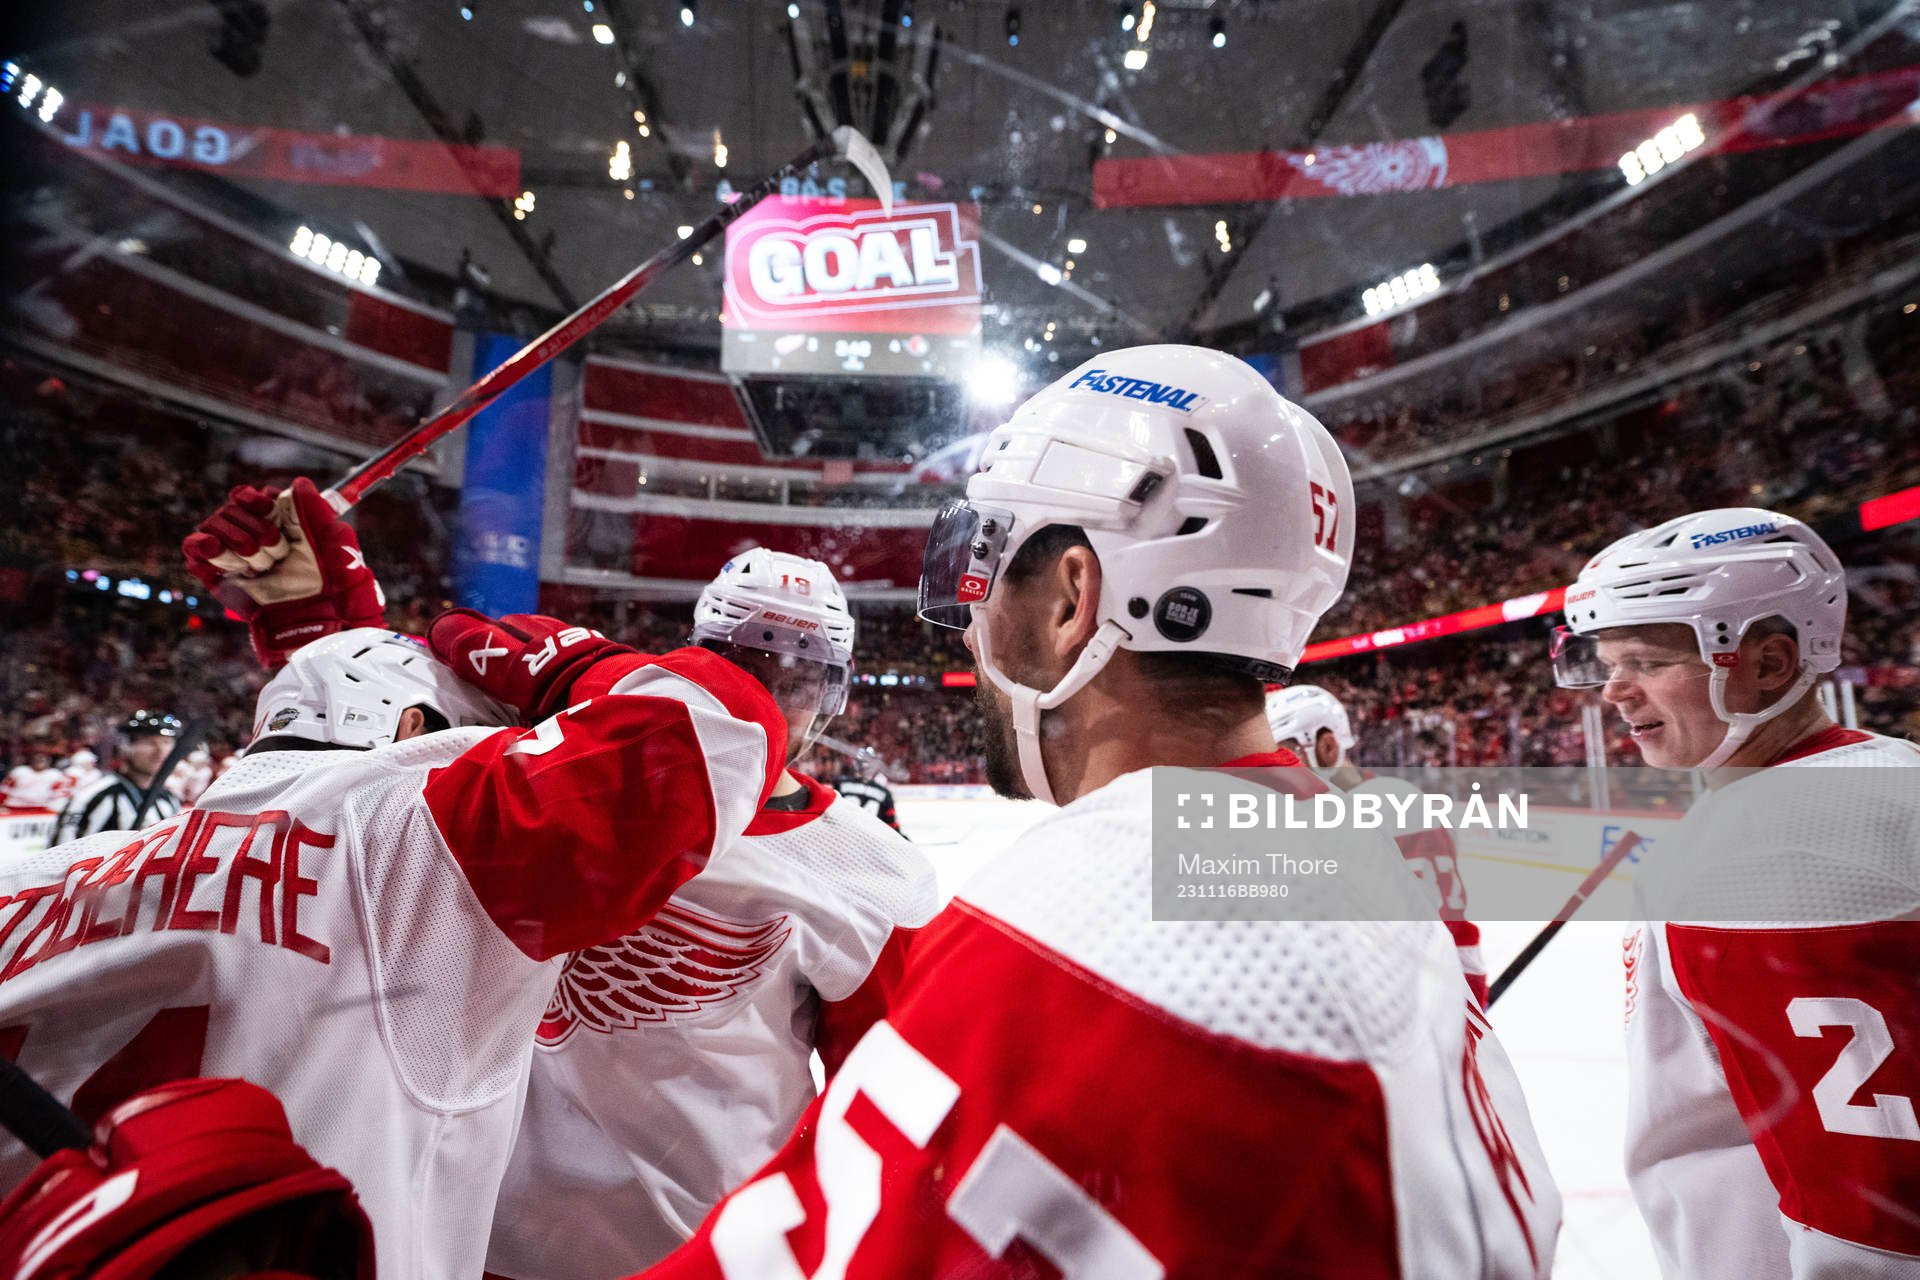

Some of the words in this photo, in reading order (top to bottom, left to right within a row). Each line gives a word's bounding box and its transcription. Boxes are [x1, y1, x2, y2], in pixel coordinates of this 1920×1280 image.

[749, 228, 957, 301] GOAL
[1069, 370, 1198, 412] FASTENAL
[1309, 480, 1339, 552] 57
[1690, 522, 1780, 550] FASTENAL
[762, 610, 819, 631] BAUER
[1785, 997, 1920, 1141] 2
